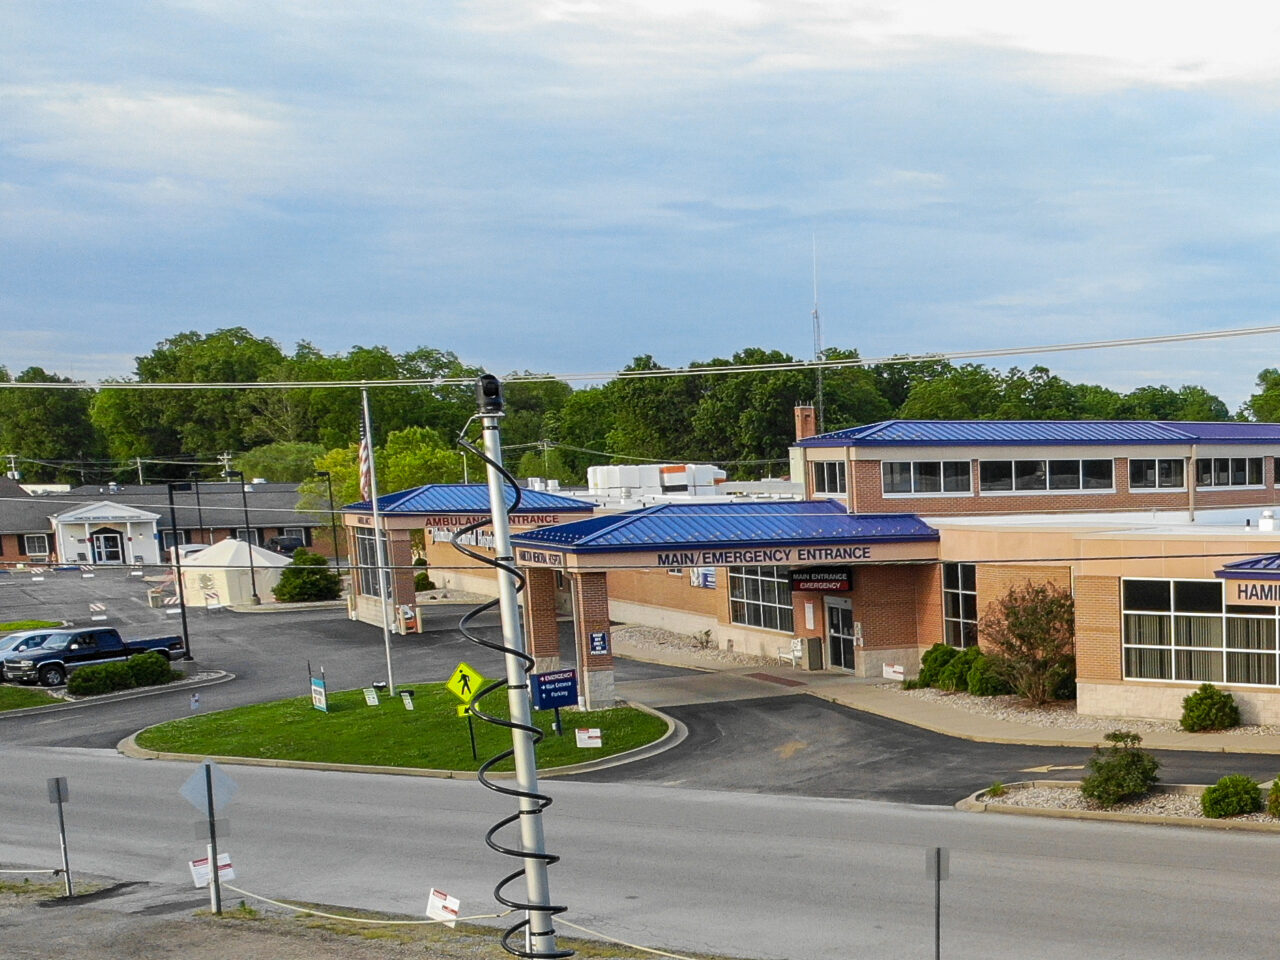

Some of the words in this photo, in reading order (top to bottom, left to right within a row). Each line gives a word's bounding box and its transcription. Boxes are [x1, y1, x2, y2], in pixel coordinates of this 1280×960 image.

[509, 514, 560, 525] NTRANCE
[657, 550, 791, 566] MAIN/EMERGENCY
[797, 547, 871, 561] ENTRANCE
